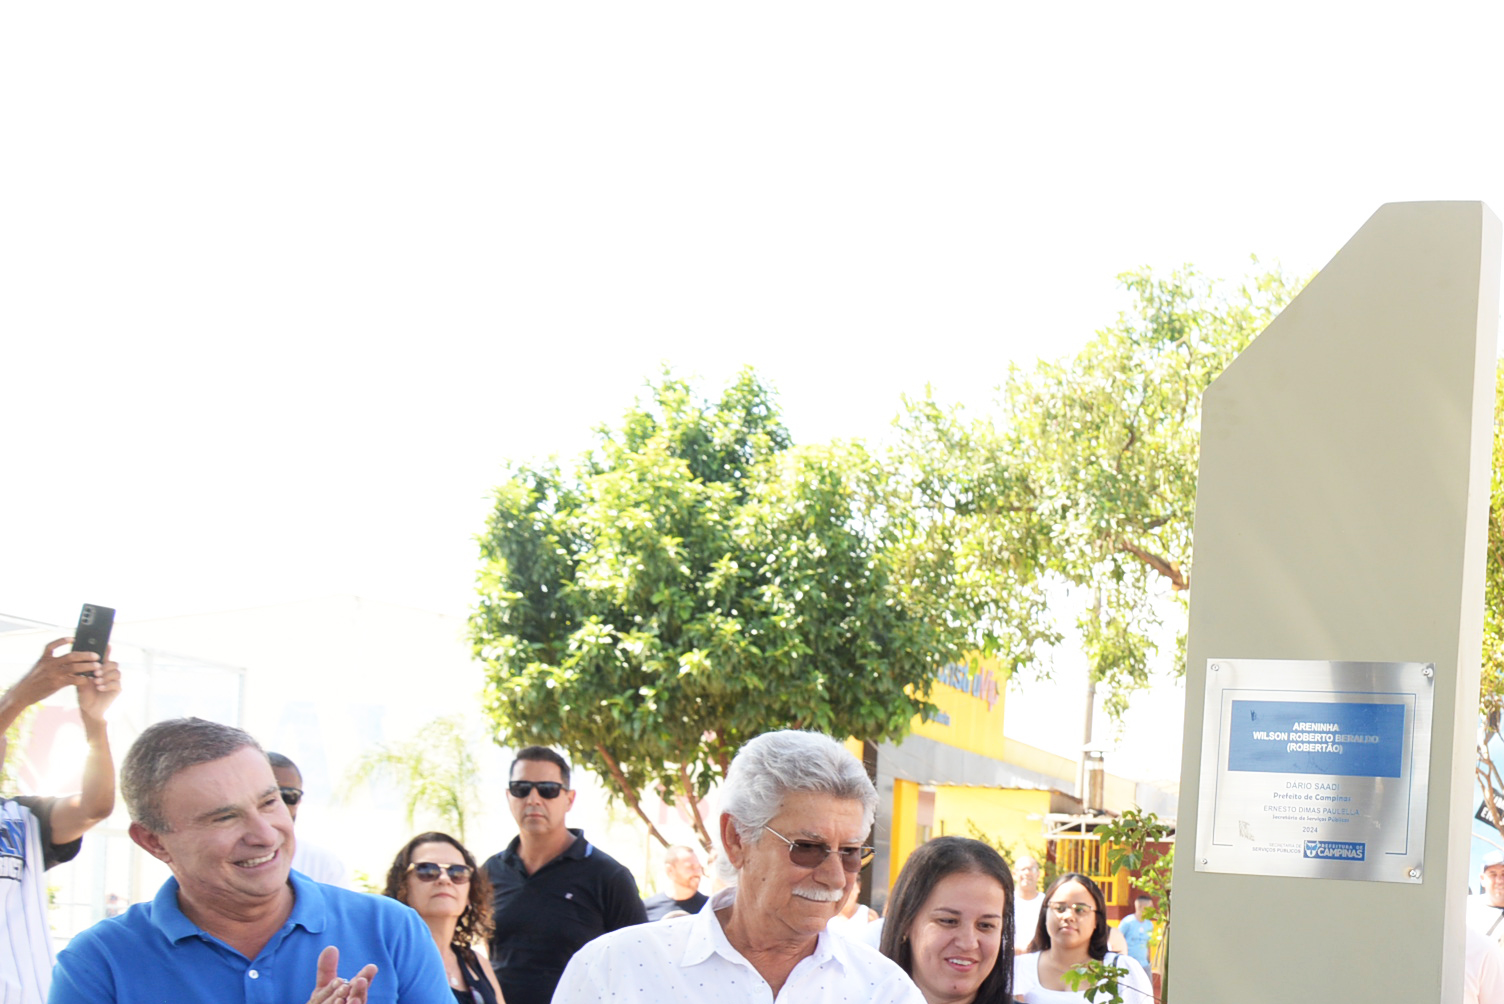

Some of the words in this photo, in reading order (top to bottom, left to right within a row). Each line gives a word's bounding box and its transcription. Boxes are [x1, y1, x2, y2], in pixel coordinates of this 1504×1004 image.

[1293, 722, 1340, 732] ARENINHA
[1253, 731, 1288, 741] WILSON
[1290, 732, 1334, 742] ROBERTO
[1335, 734, 1379, 744] BERALDO
[1287, 742, 1343, 754] (ROBERTÃO)
[1314, 782, 1340, 791] SAADI
[1273, 791, 1302, 800] Prefeito
[1303, 793, 1313, 801] de
[1314, 793, 1352, 803] Campinas
[1263, 804, 1297, 813] ERNESTO
[1298, 806, 1321, 814] DIMAS
[1317, 848, 1363, 858] CAMPINAS
